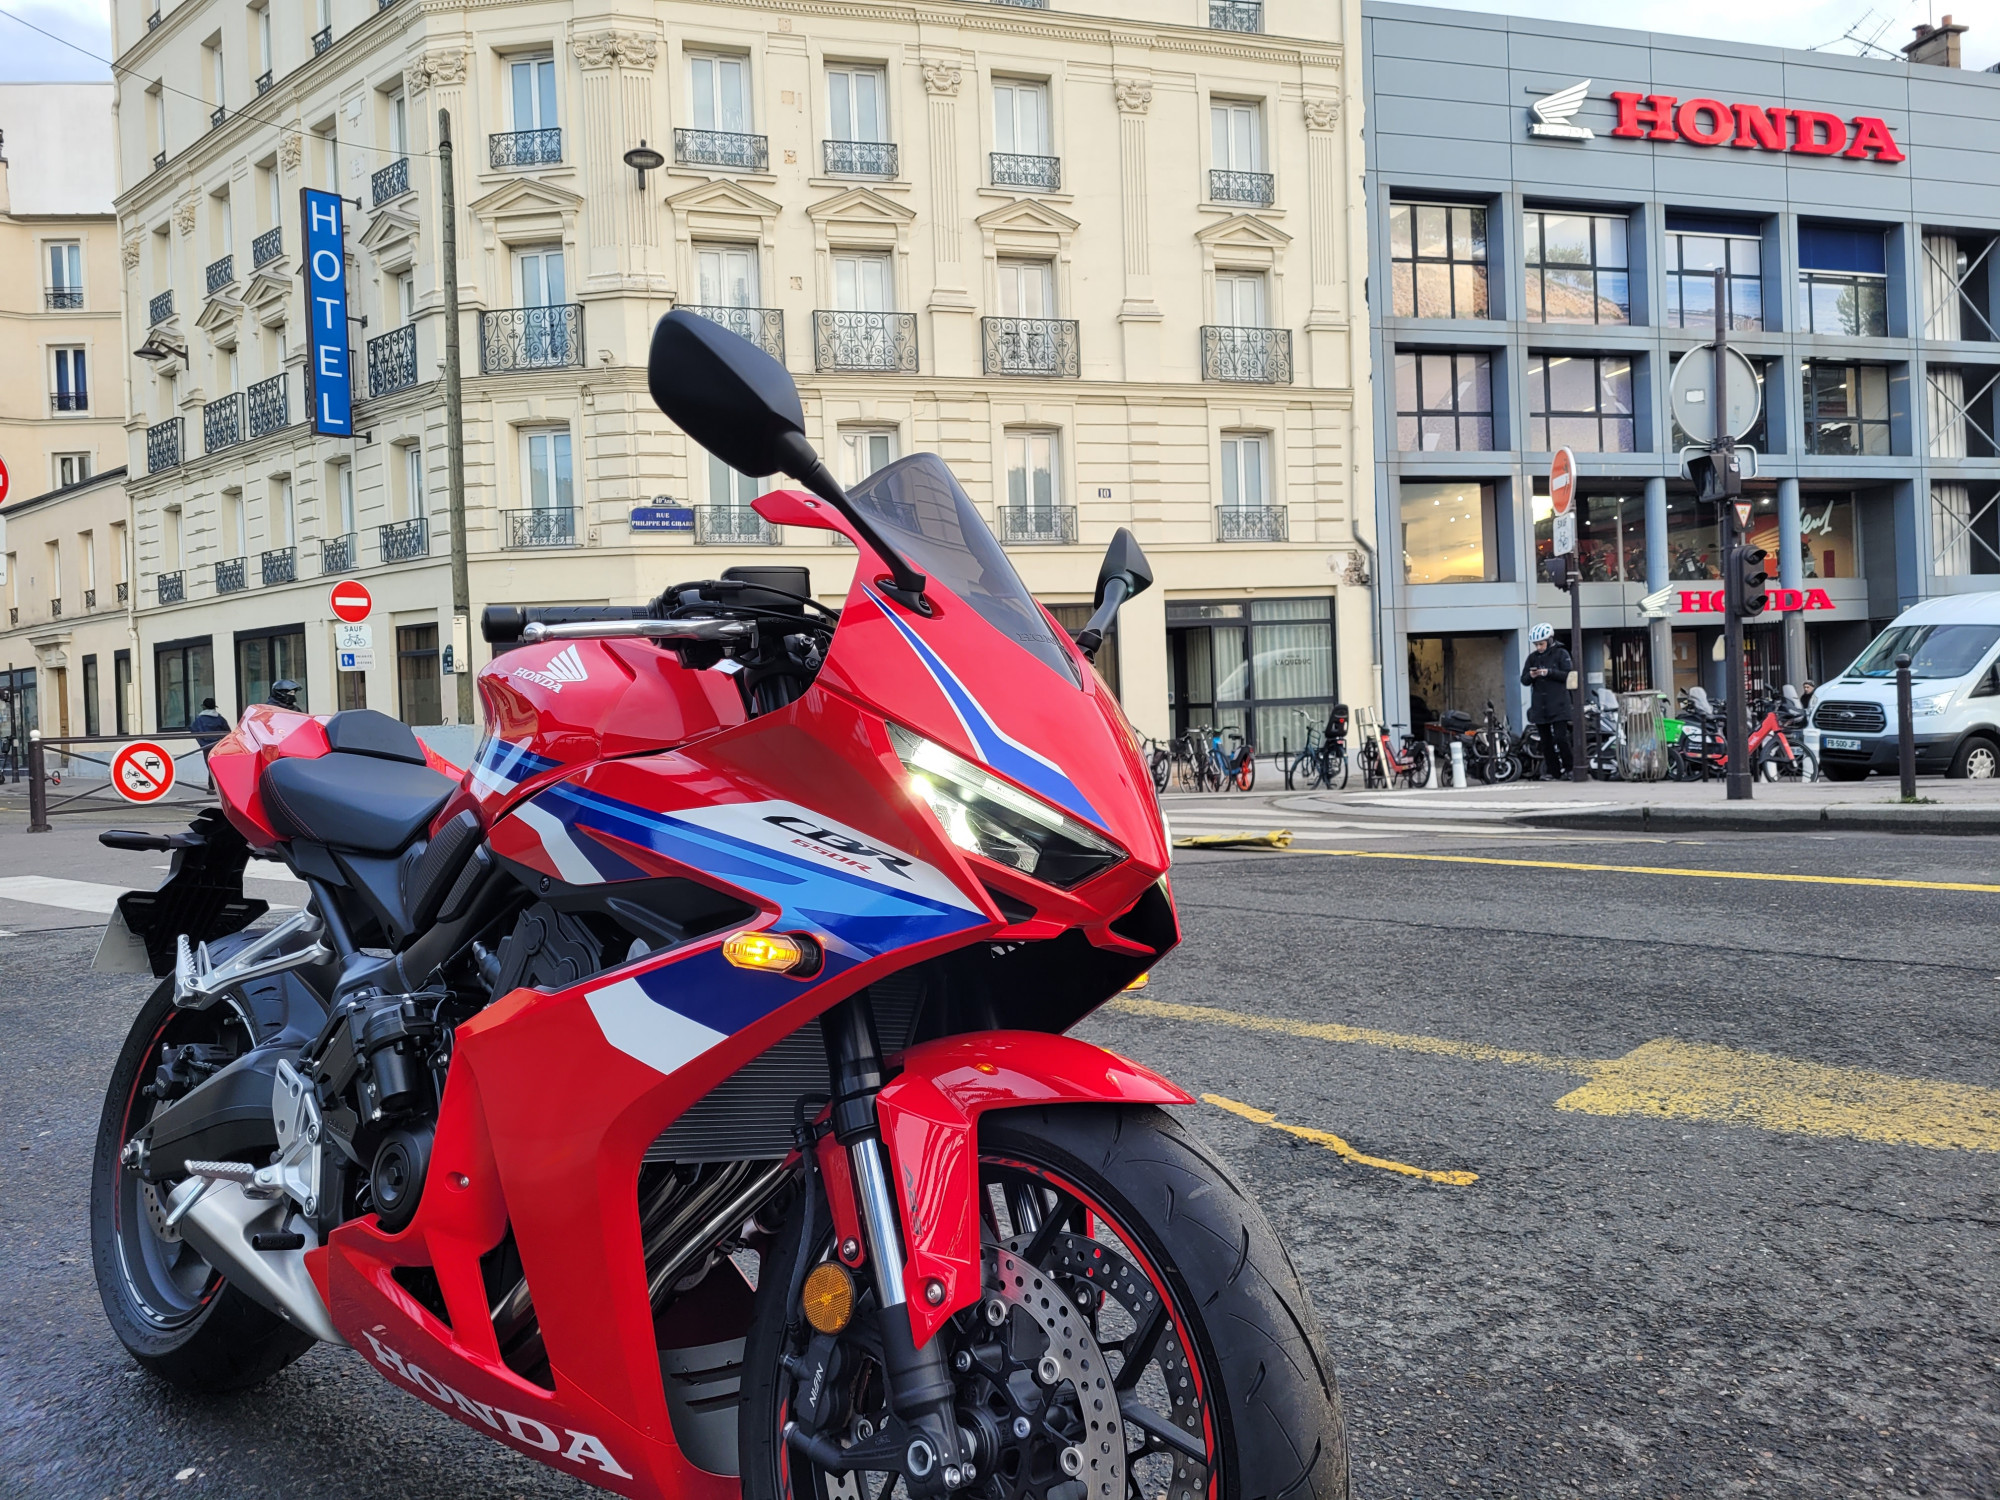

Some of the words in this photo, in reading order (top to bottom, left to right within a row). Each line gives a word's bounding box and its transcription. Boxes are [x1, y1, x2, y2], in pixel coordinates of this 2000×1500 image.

[1530, 123, 1596, 139] HONDA
[1610, 91, 1905, 164] HONDA
[311, 201, 344, 425] HOTEL
[1677, 588, 1836, 613] HDA
[344, 625, 363, 633] SAUF
[512, 667, 563, 694] HONDA
[762, 815, 916, 882] CBR
[790, 838, 872, 875] 650R
[361, 1329, 634, 1480] HONDA
